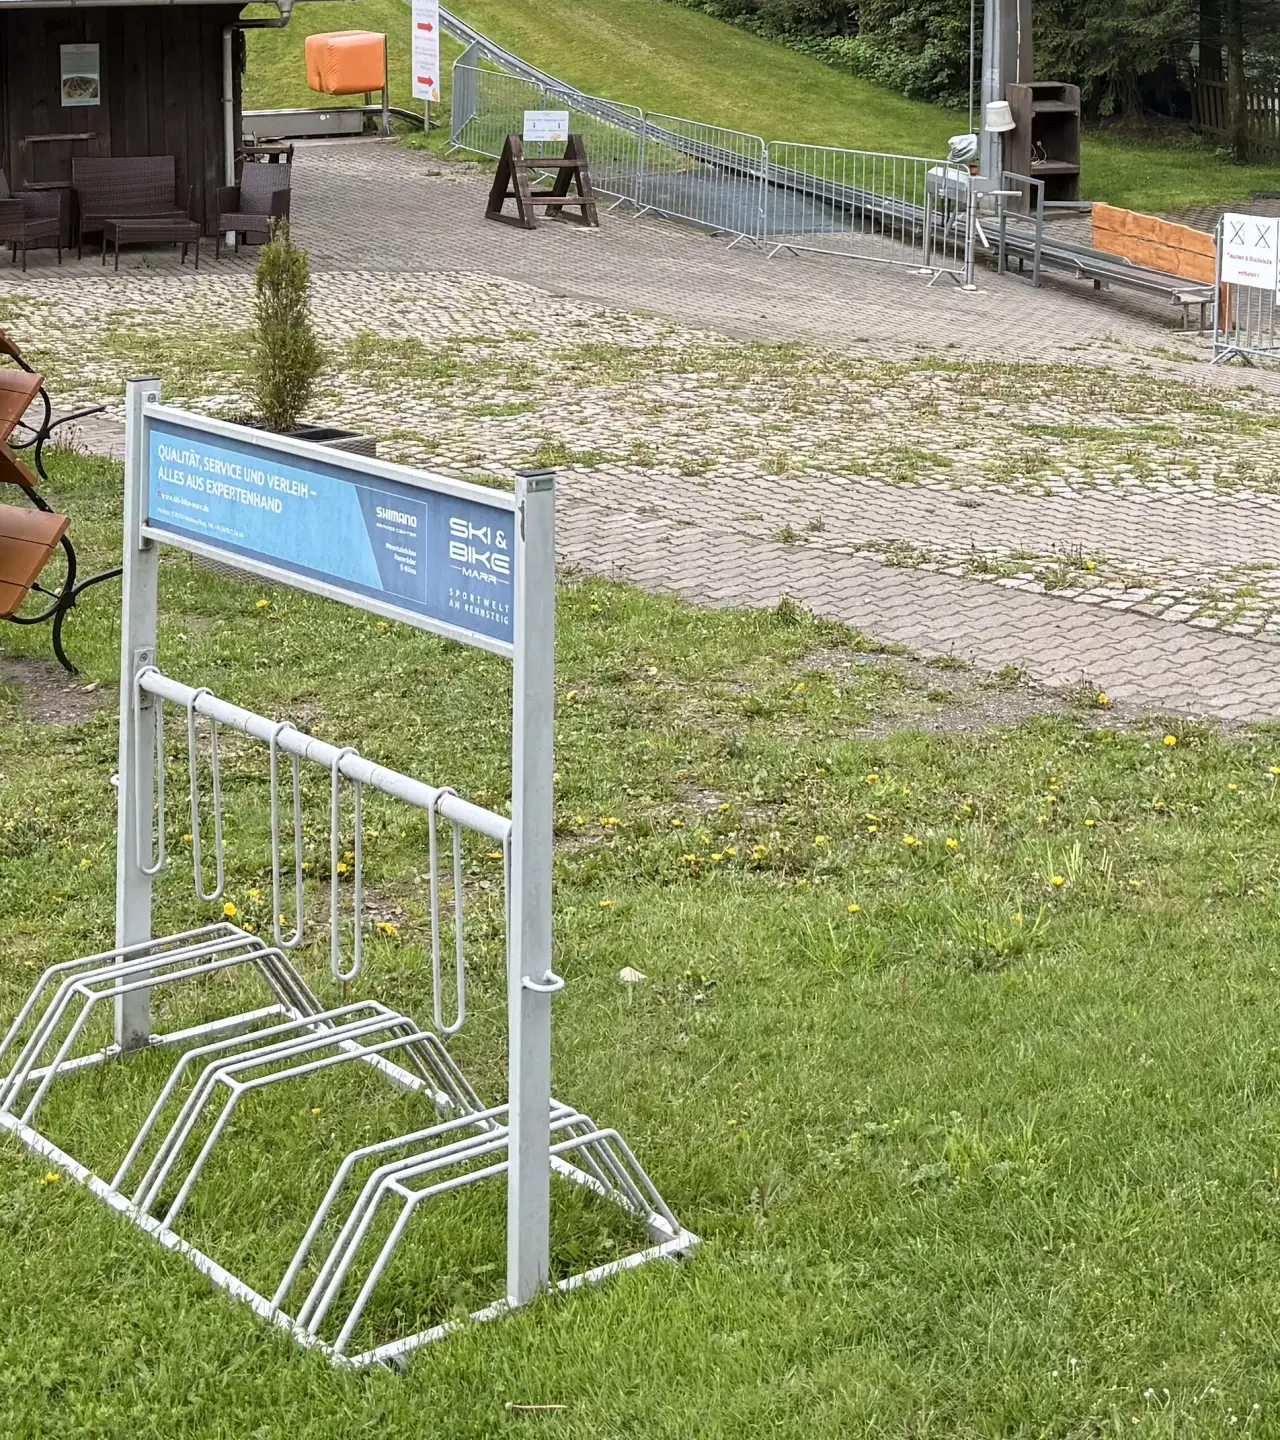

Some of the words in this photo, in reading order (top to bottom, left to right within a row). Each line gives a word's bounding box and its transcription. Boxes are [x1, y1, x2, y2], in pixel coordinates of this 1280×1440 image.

[158, 444, 202, 471] QUALITÄT,
[204, 457, 242, 478] SERVICE
[244, 468, 265, 486] UND
[268, 474, 308, 499] VERLEIH
[158, 466, 184, 486] ALLES
[186, 476, 204, 491] AUS
[206, 480, 282, 514] EXPERTENHAND
[376, 507, 417, 528] SHIMANO
[449, 517, 491, 545] SKI
[495, 530, 508, 549] &
[449, 540, 510, 575] BIKE
[462, 567, 497, 585] MARR
[449, 587, 509, 613] SPORTWELT
[449, 599, 460, 609] AM
[464, 604, 509, 625] RENNSTEIG
